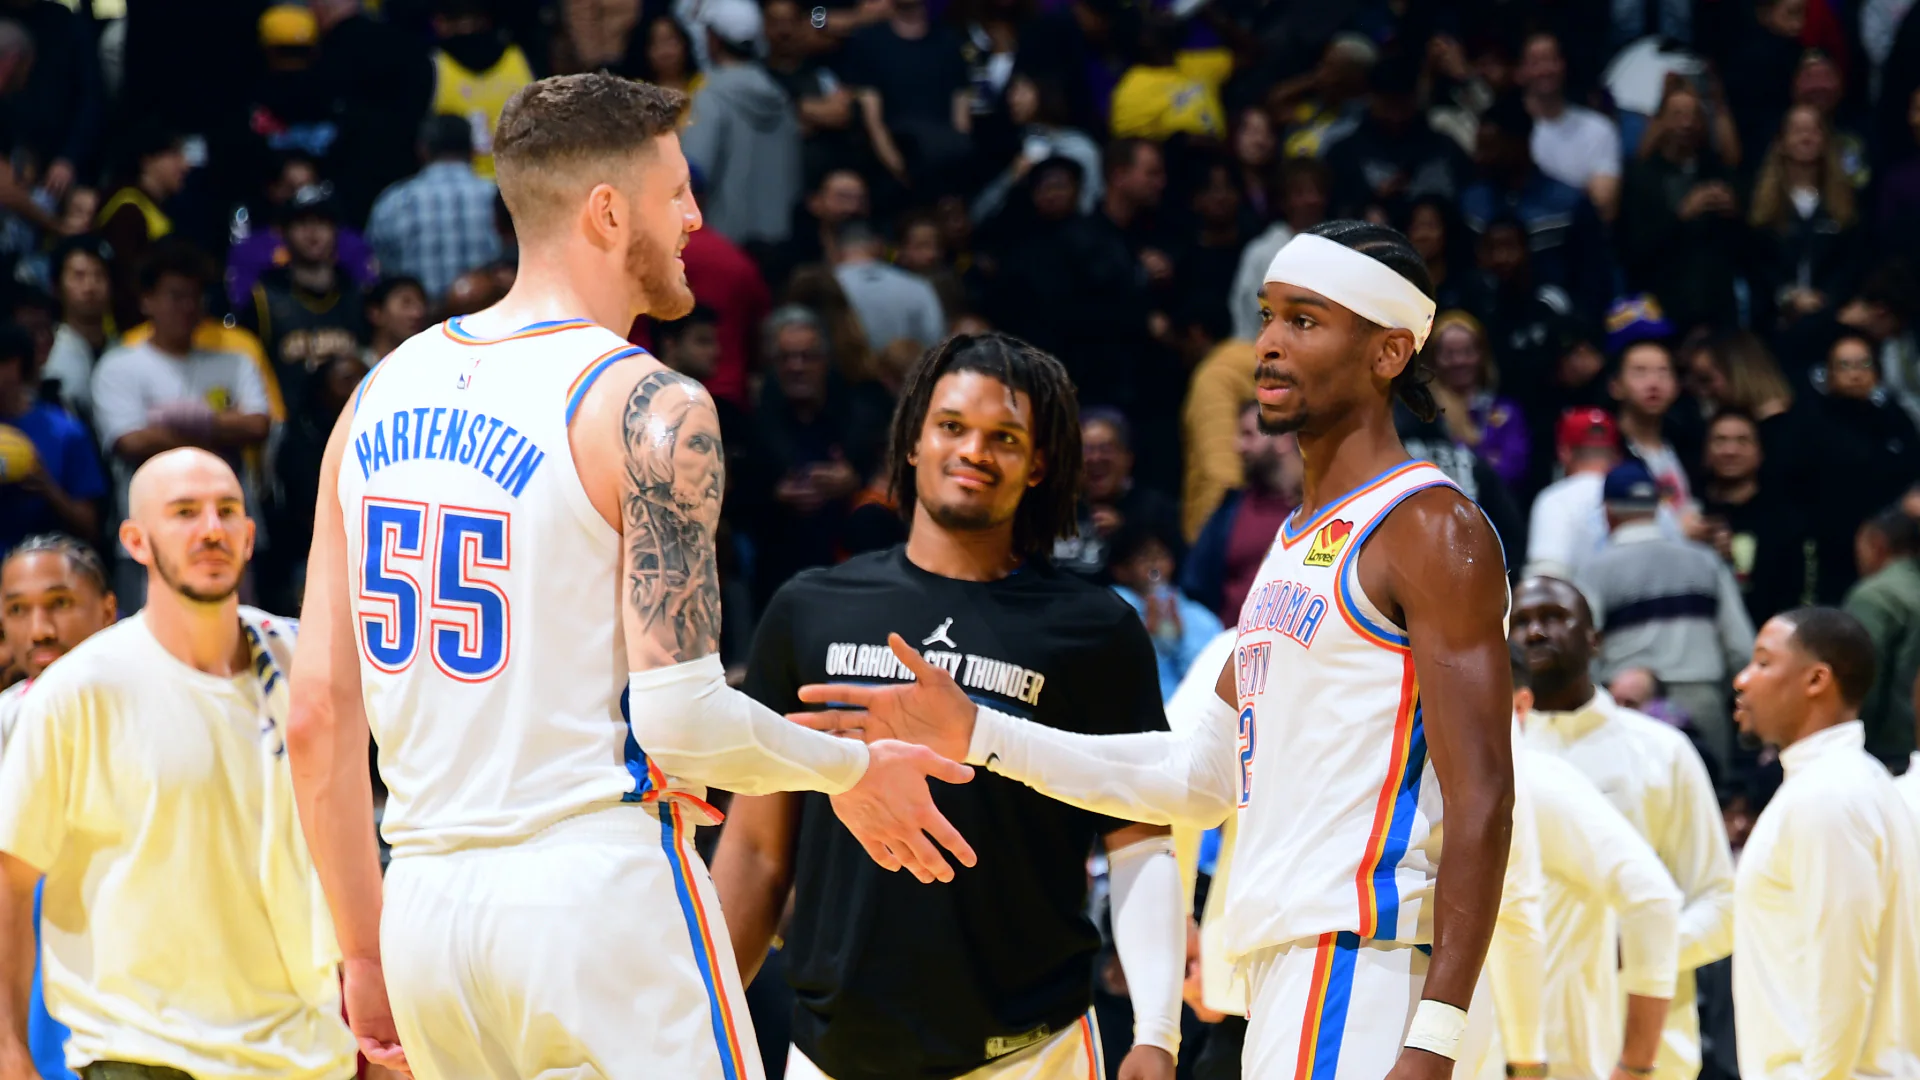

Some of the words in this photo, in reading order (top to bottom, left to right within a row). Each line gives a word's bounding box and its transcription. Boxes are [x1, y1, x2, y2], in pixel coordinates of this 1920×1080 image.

[354, 407, 545, 499] HARTENSTEIN
[358, 496, 511, 684] 55
[1240, 580, 1329, 650] LAHOMA
[961, 654, 1045, 706] THUNDER
[1238, 641, 1272, 700] CITY
[1237, 701, 1257, 809] 2
